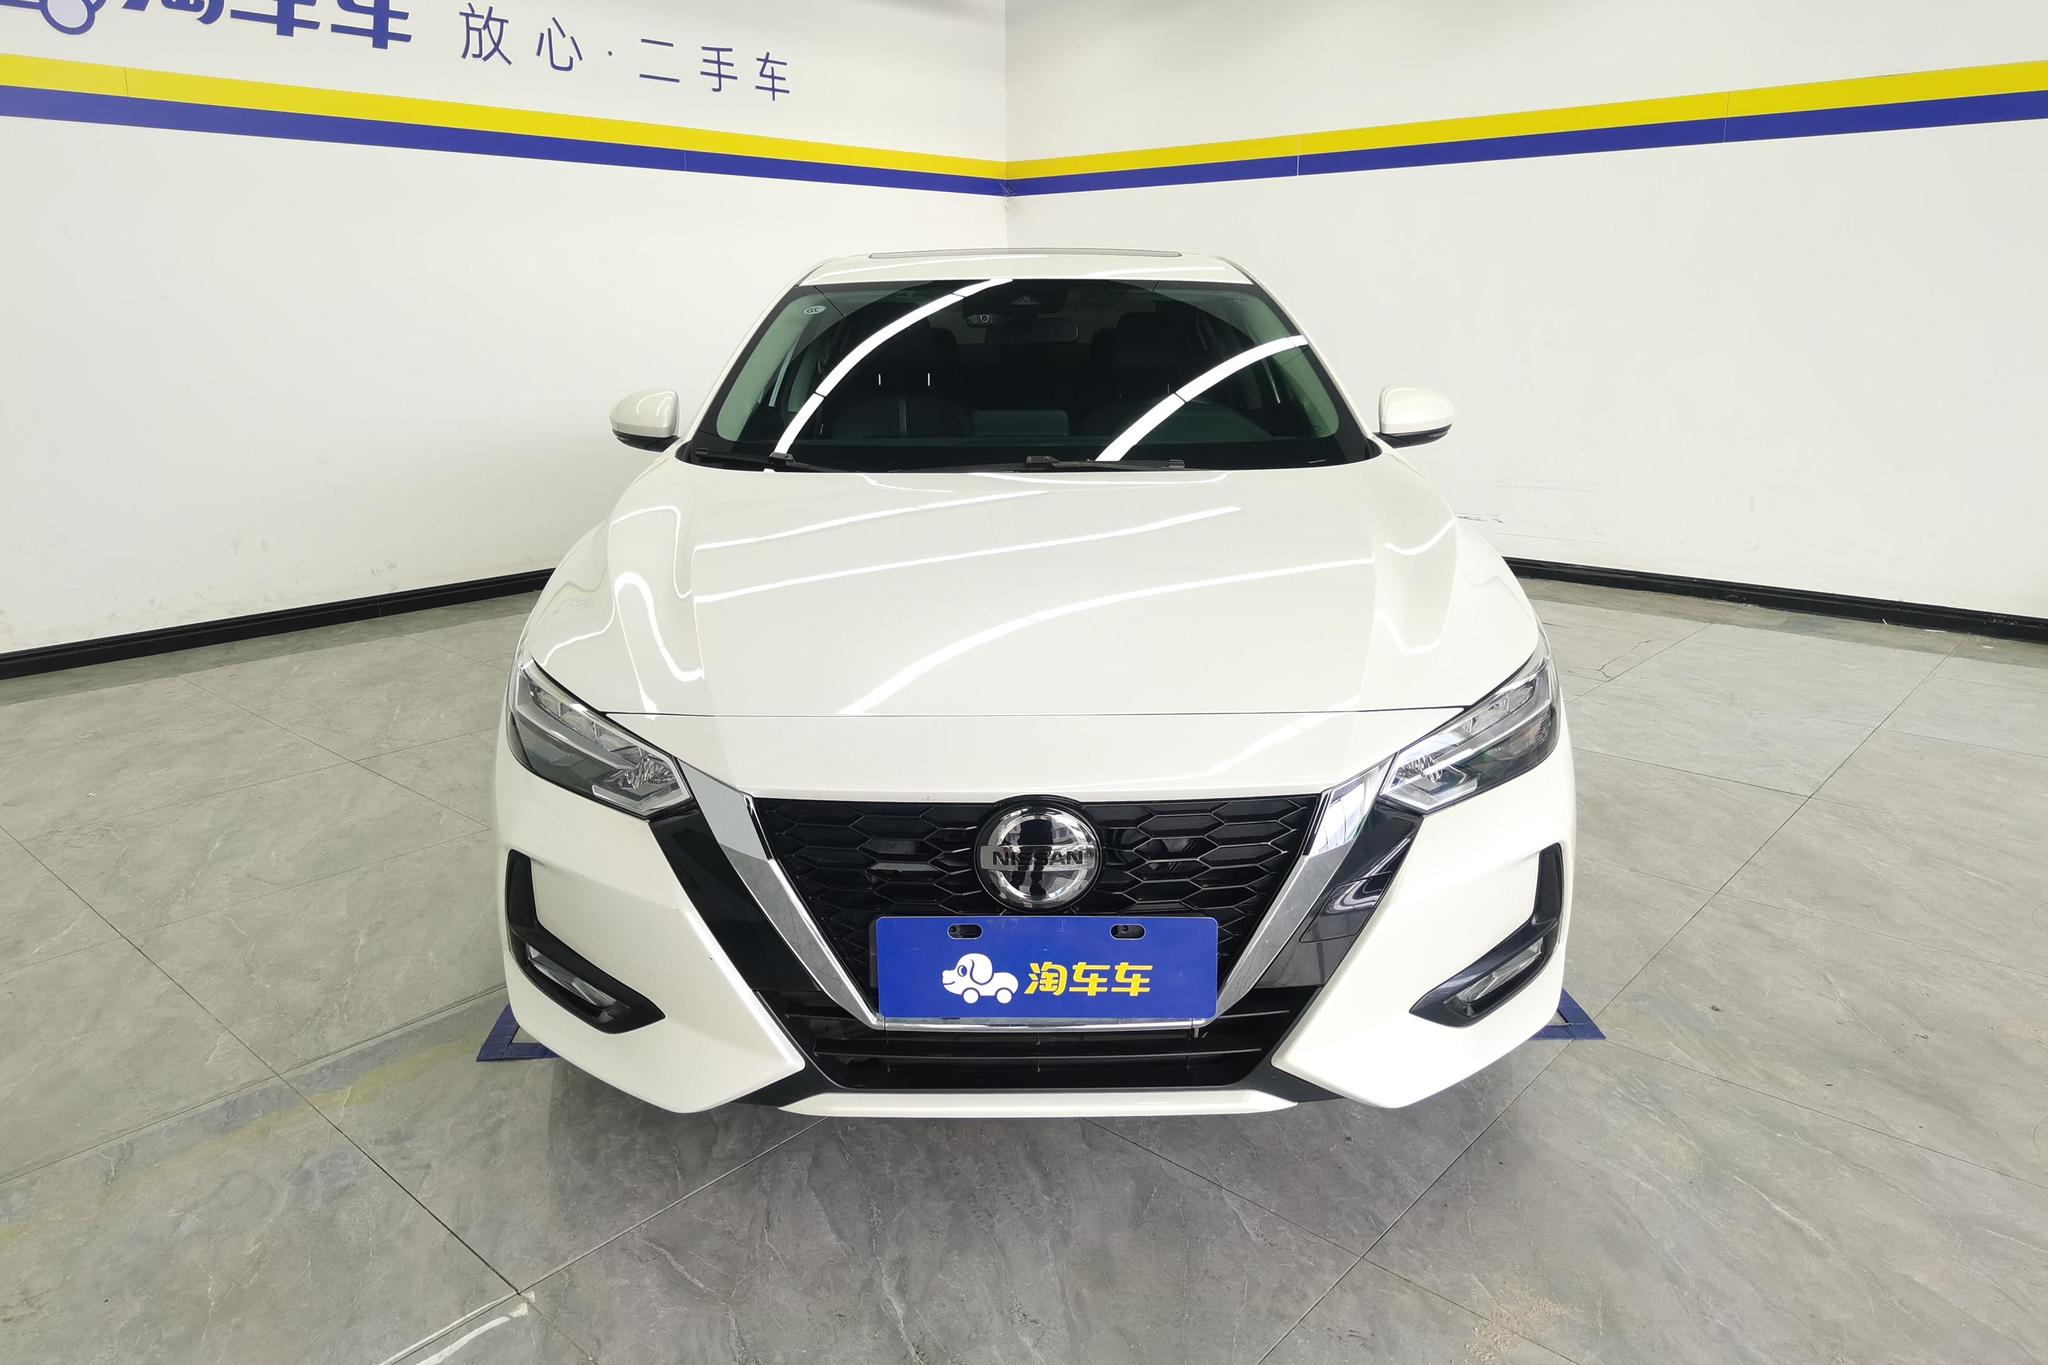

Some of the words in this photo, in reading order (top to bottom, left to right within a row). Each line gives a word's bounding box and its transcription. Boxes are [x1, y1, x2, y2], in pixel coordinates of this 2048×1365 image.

[992, 851, 1083, 865] NIAN
[1025, 962, 1153, 996] 淘车车
